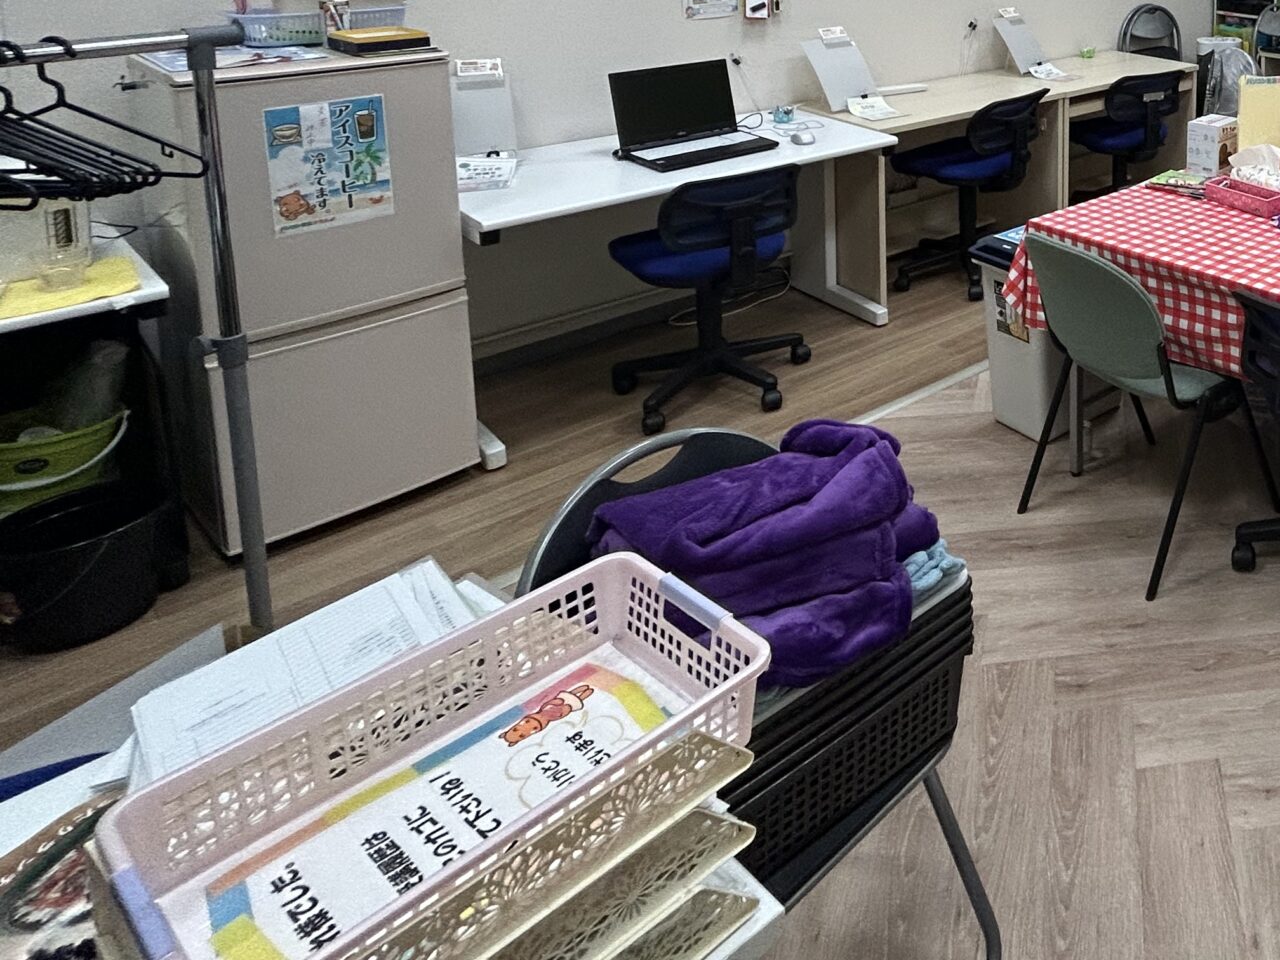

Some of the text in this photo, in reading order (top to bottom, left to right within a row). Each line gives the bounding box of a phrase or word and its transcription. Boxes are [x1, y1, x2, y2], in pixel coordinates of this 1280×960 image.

[311, 153, 331, 213] 冷えてます。
[331, 104, 357, 208] アイスコーヒー
